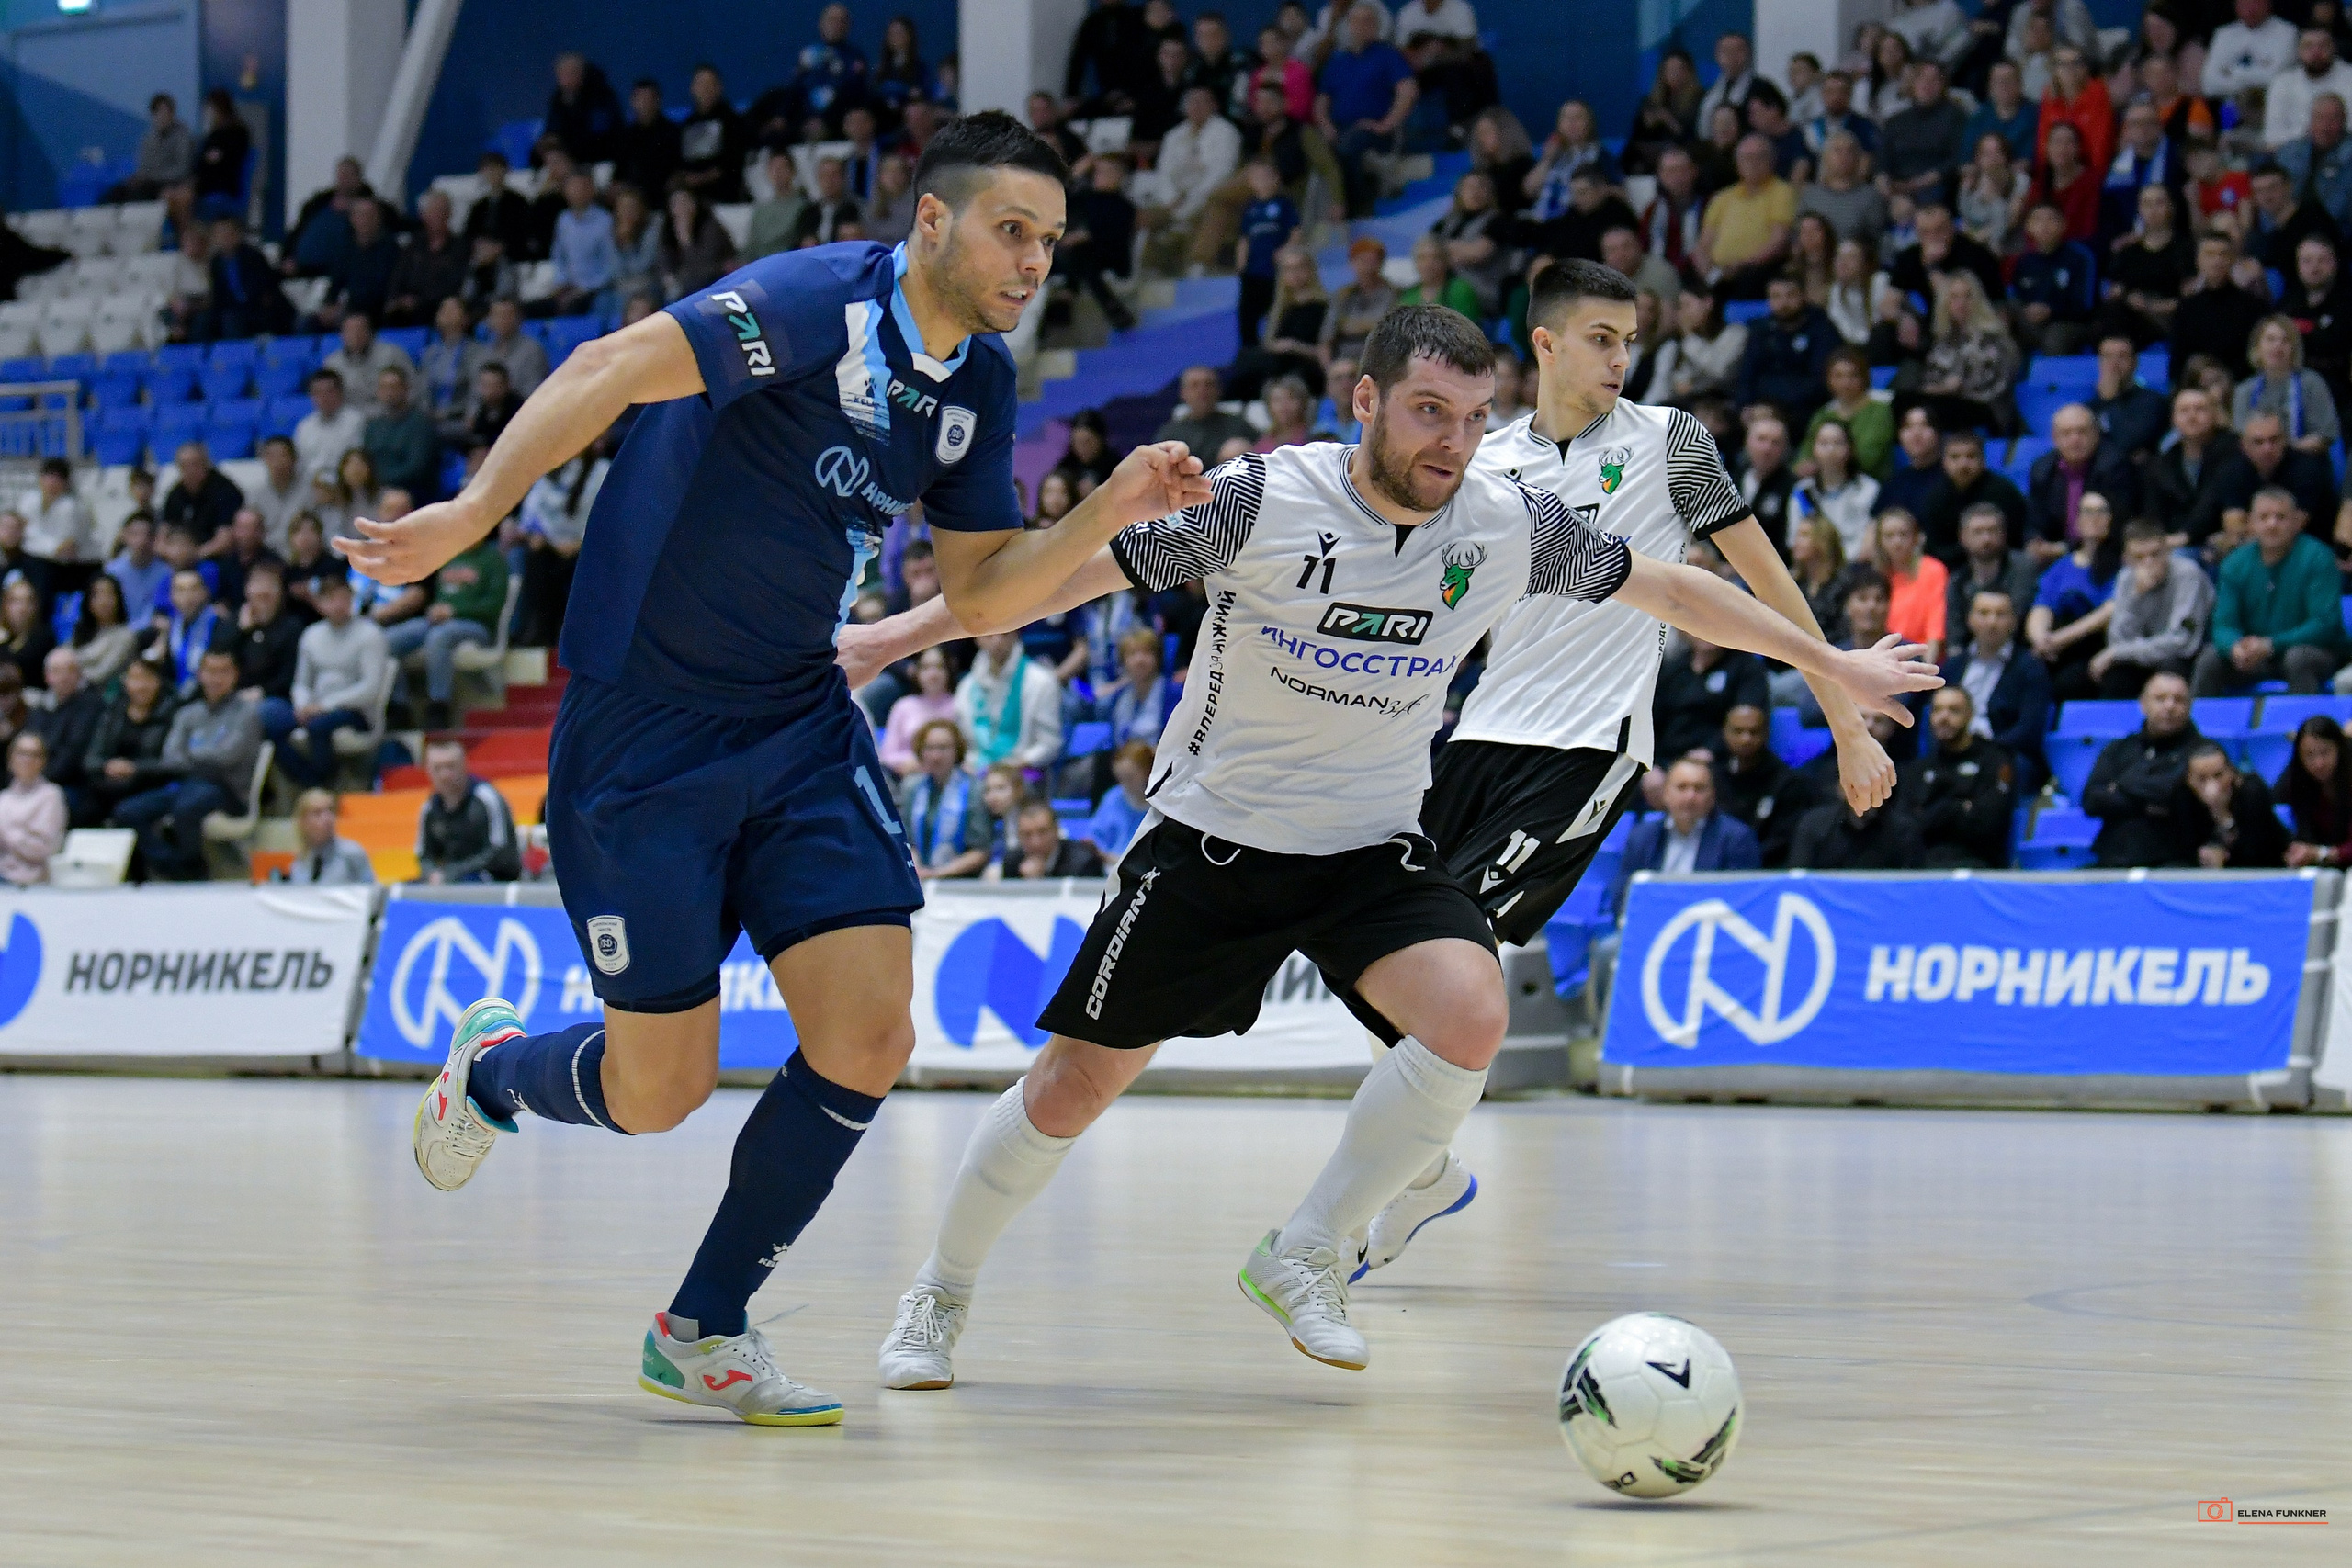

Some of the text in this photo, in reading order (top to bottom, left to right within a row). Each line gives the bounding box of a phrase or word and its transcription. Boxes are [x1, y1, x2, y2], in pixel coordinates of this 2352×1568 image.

[711, 290, 775, 377] PARI
[1295, 554, 1337, 595] 71
[1322, 606, 1428, 639] PARI
[1495, 829, 1542, 874] 11
[65, 950, 334, 992] НОРНИКЕЛЬ
[1863, 942, 2272, 1007] НОРНИКЕЛЬ
